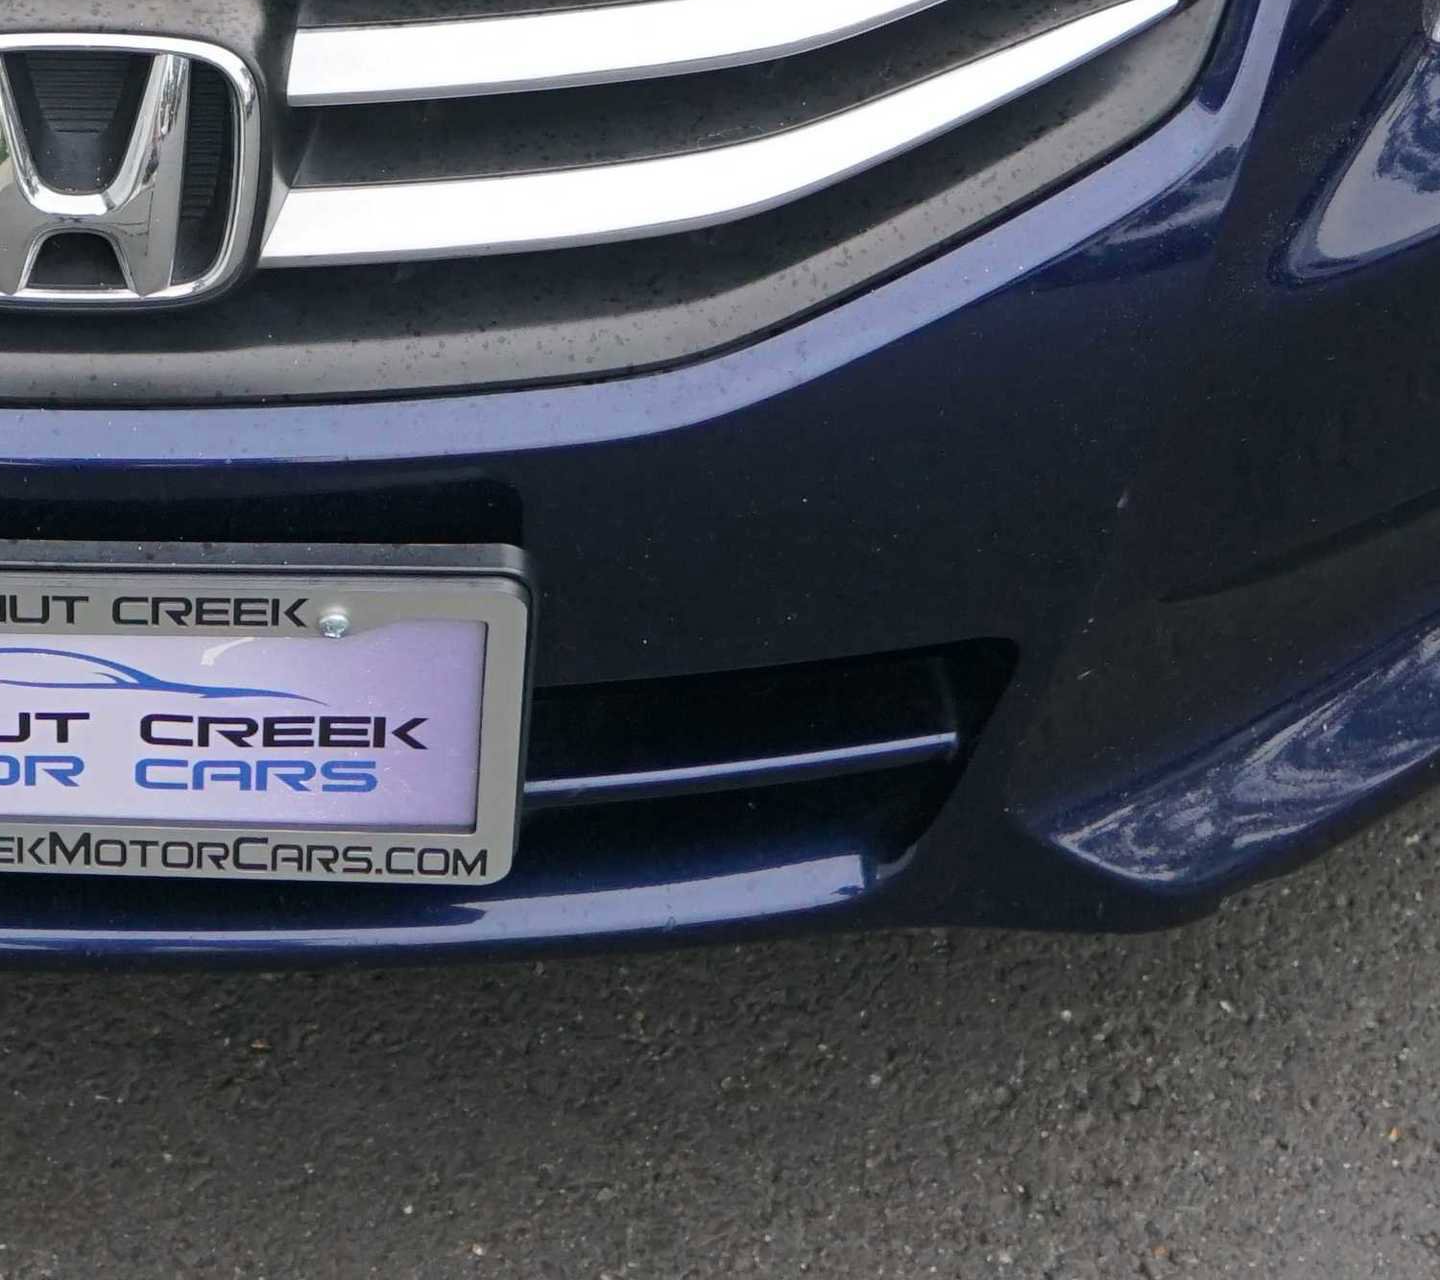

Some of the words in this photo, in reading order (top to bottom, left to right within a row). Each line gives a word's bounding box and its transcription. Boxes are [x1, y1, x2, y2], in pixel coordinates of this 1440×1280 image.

[111, 594, 310, 628] CREEK
[138, 714, 429, 750] CREEK
[134, 756, 378, 793] CARS
